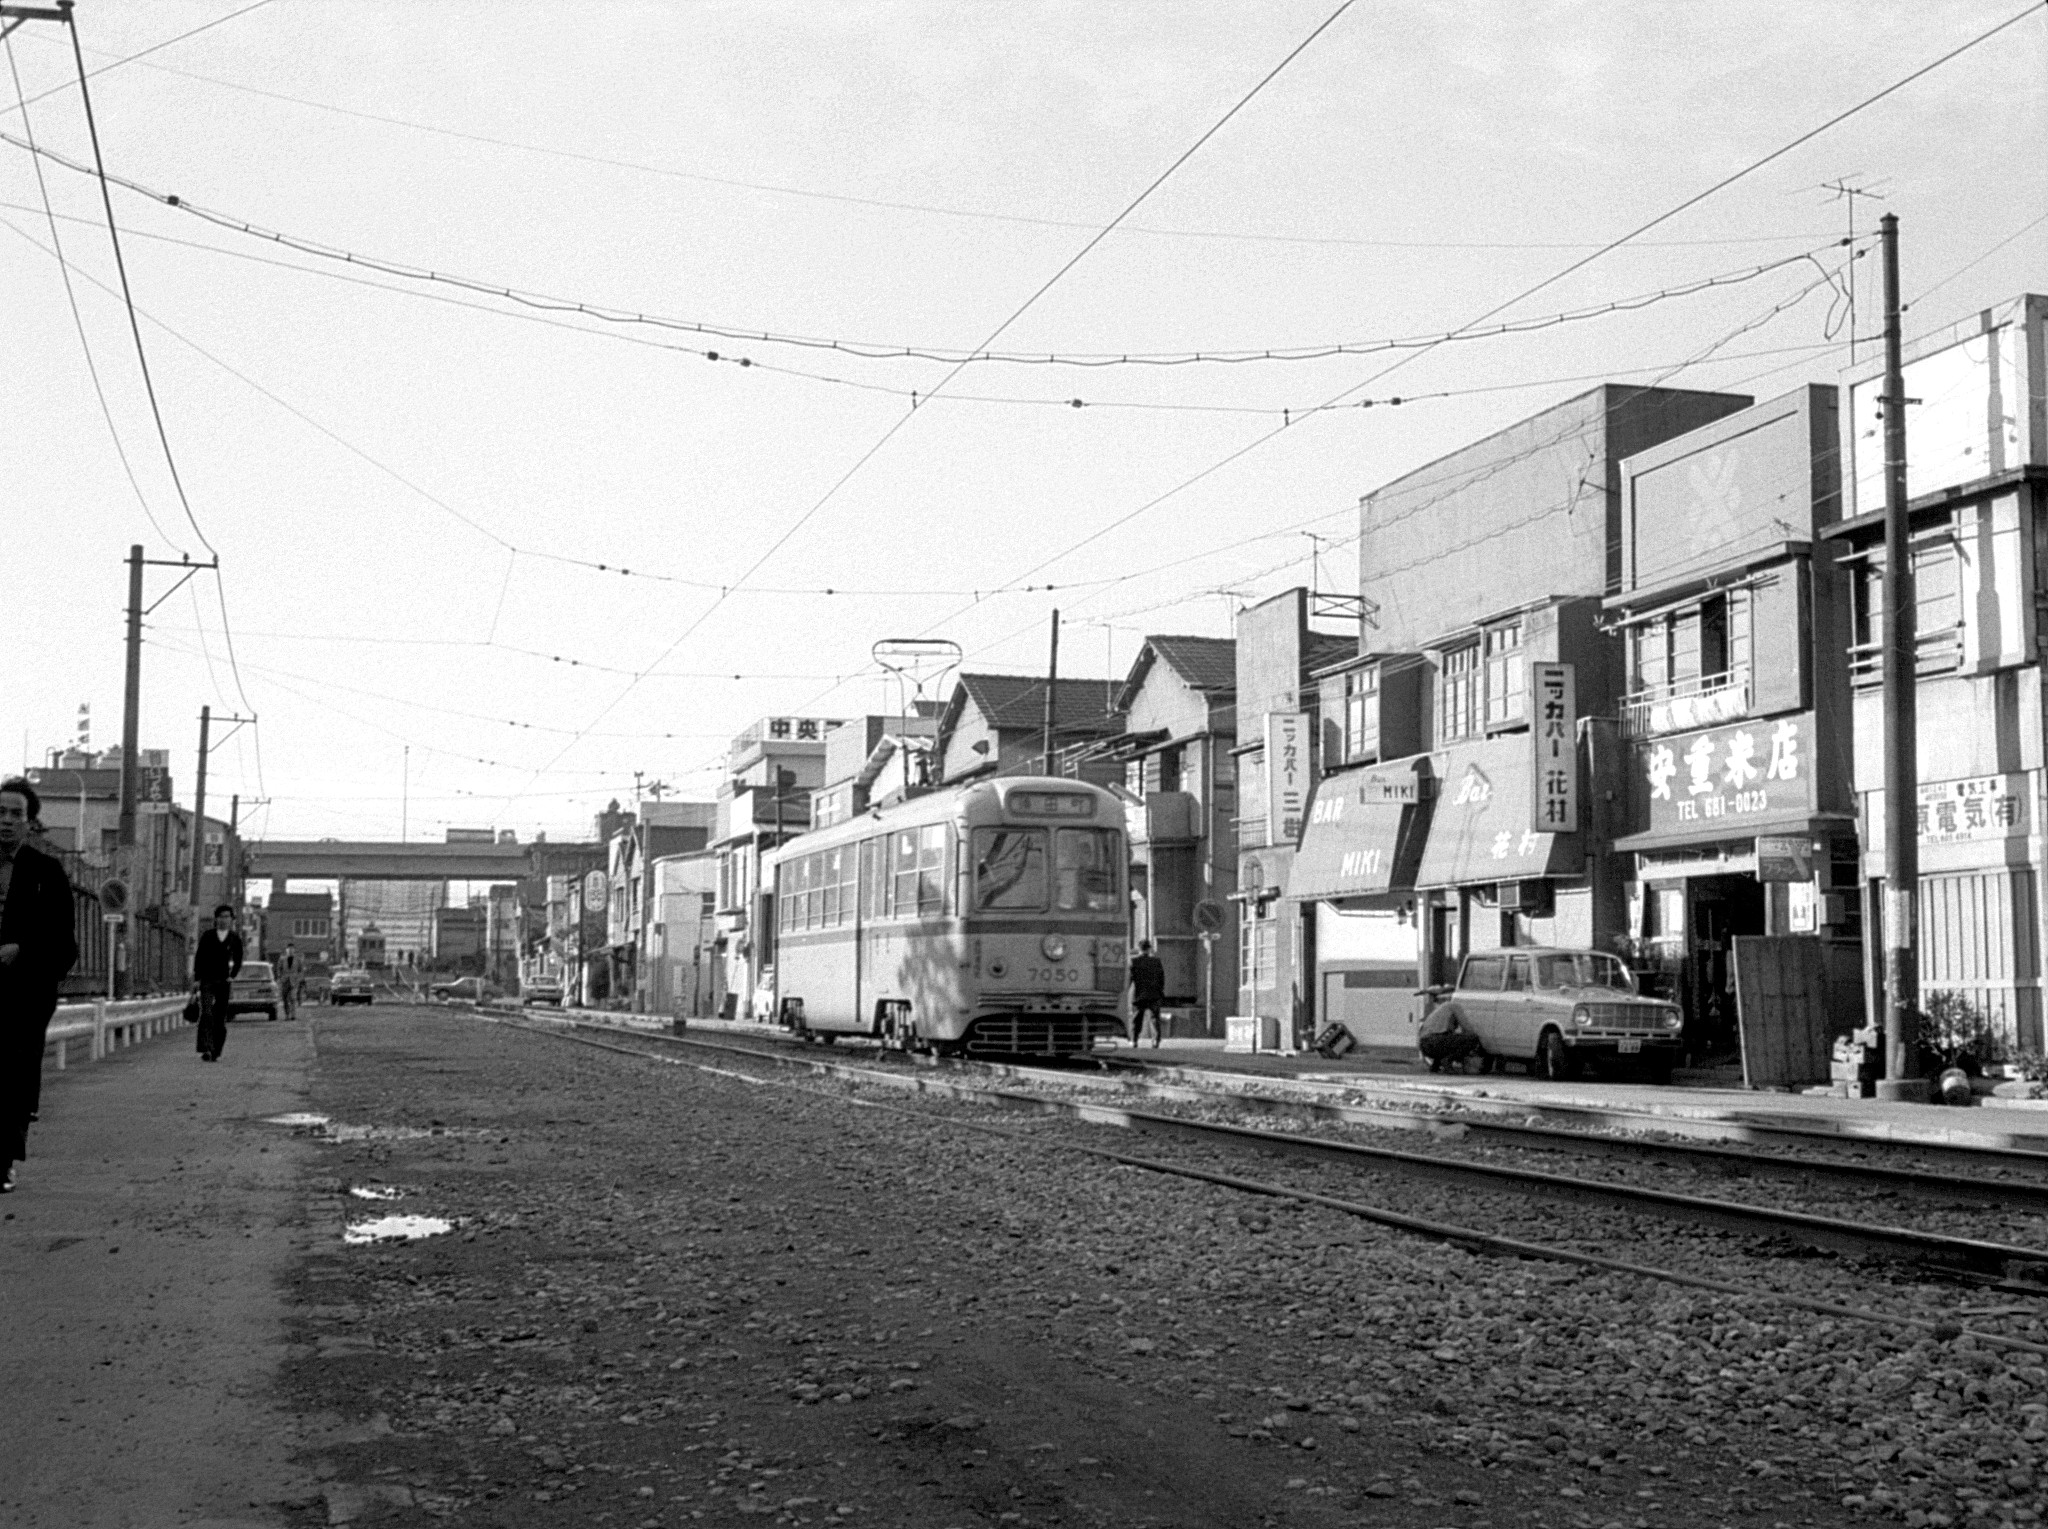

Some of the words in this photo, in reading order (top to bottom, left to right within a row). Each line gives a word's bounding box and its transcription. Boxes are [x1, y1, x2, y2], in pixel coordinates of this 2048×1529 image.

[1383, 785, 1415, 799] MIKI
[1546, 770, 1568, 823] 花村
[1677, 800, 1698, 820] TEL
[1704, 789, 1768, 818] 681-0023
[1313, 796, 1344, 824] BAR
[1340, 848, 1381, 878] MIKI
[1101, 943, 1125, 965] 29
[1027, 967, 1079, 982] 7050
